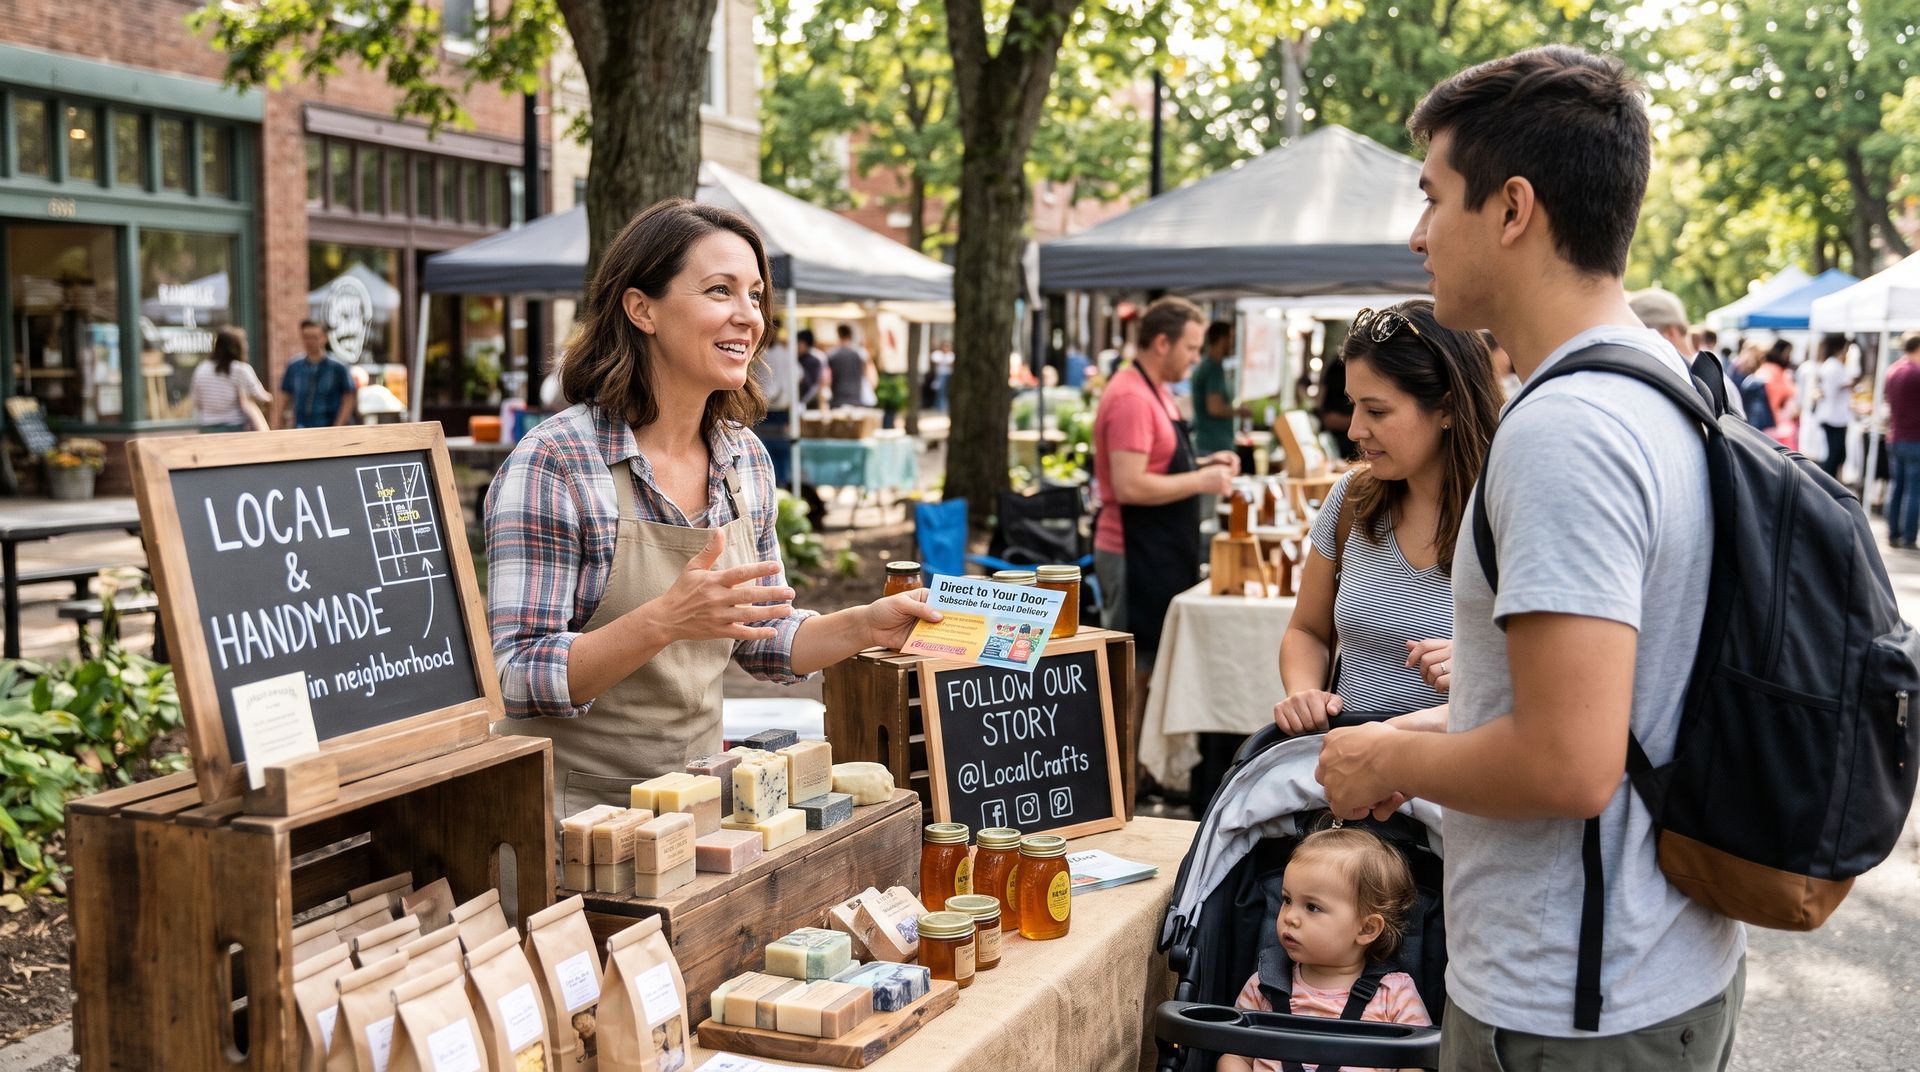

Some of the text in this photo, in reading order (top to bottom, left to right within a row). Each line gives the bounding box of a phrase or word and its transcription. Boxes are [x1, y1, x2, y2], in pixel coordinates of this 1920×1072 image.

[204, 485, 351, 552] LOCAL
[285, 551, 312, 593] &
[939, 581, 974, 597] Direct
[976, 586, 988, 598] to
[992, 588, 1019, 602] Your
[938, 594, 978, 608] Subscribe
[979, 599, 992, 609] for
[992, 602, 1015, 613] Local
[211, 586, 392, 670] HANDMADE
[307, 674, 330, 700] in
[334, 636, 455, 697] neighborhood
[947, 664, 1087, 712] FOLLOW OUR
[982, 703, 1059, 747] STORY
[957, 745, 1090, 794] @LocalCrafts
